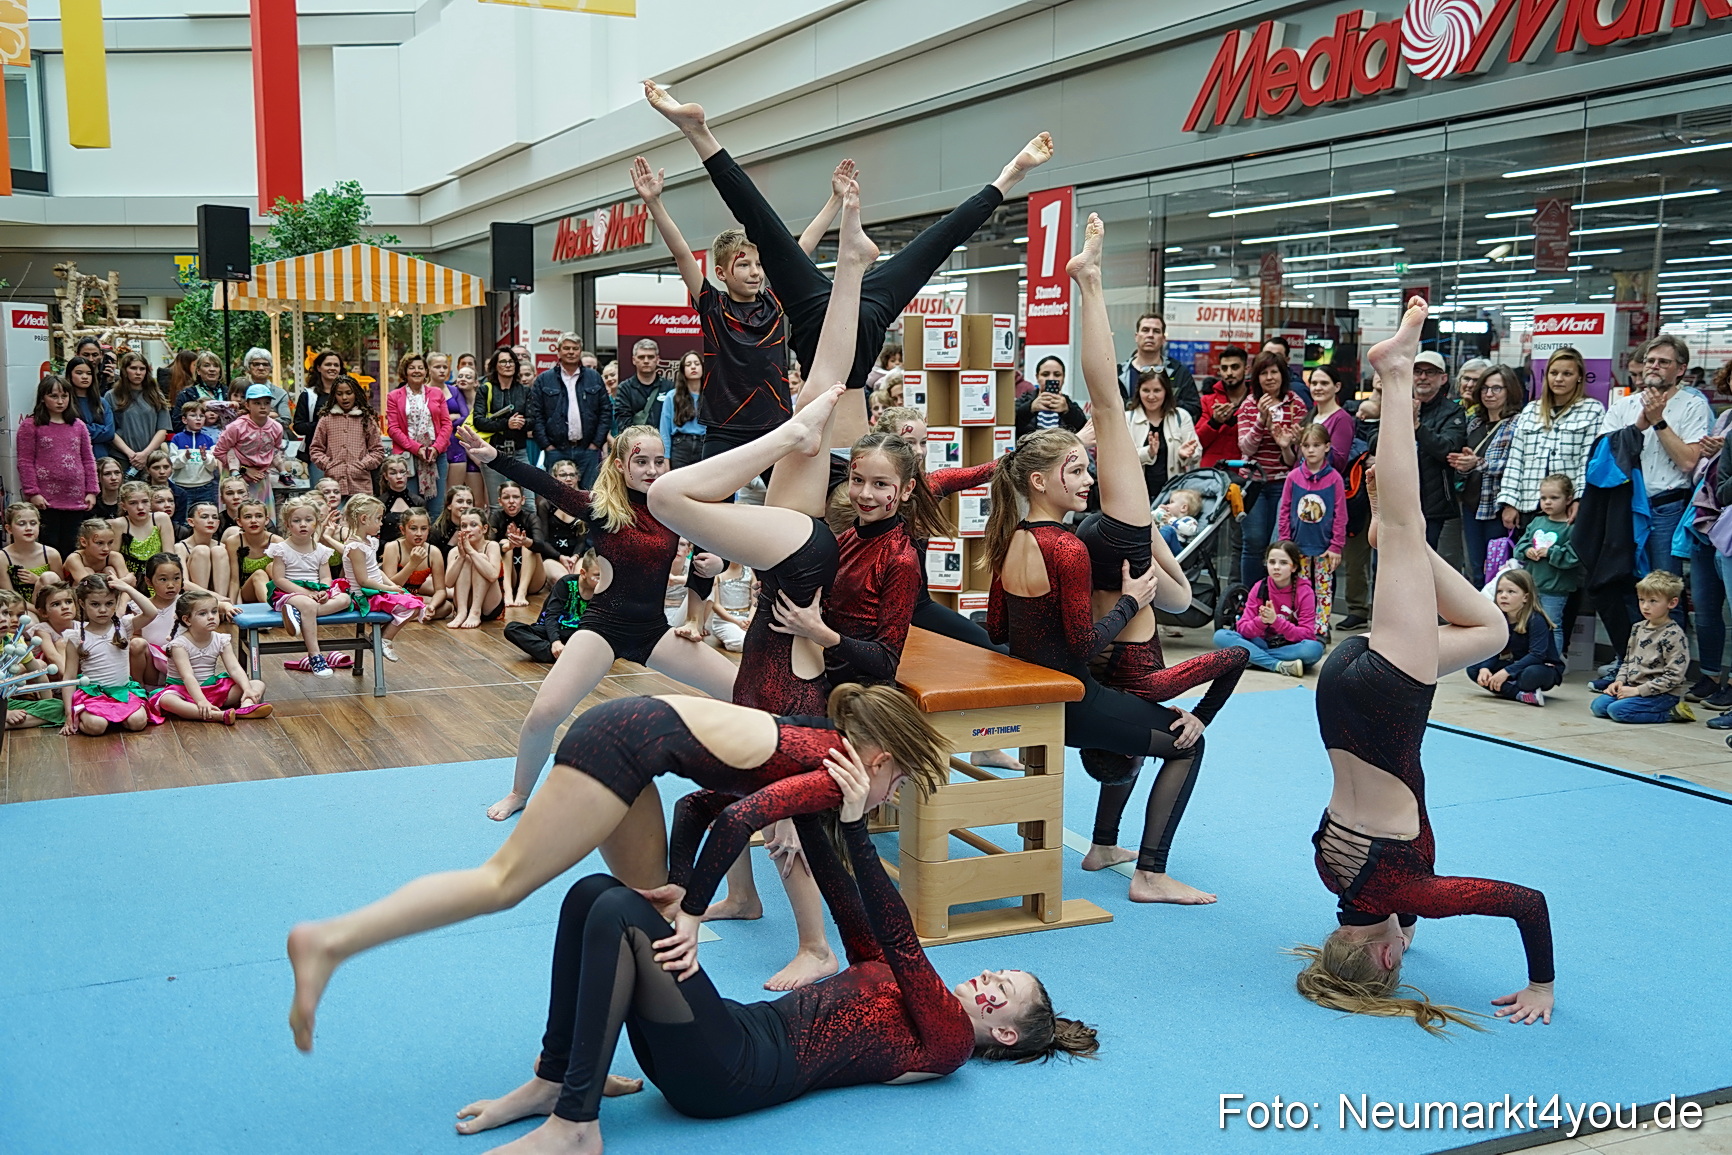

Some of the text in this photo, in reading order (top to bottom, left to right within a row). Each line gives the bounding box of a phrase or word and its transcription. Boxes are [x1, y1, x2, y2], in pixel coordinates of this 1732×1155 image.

[1040, 200, 1062, 278] 1
[1035, 284, 1061, 299] Stunde
[1196, 306, 1262, 322] SOFTWARE
